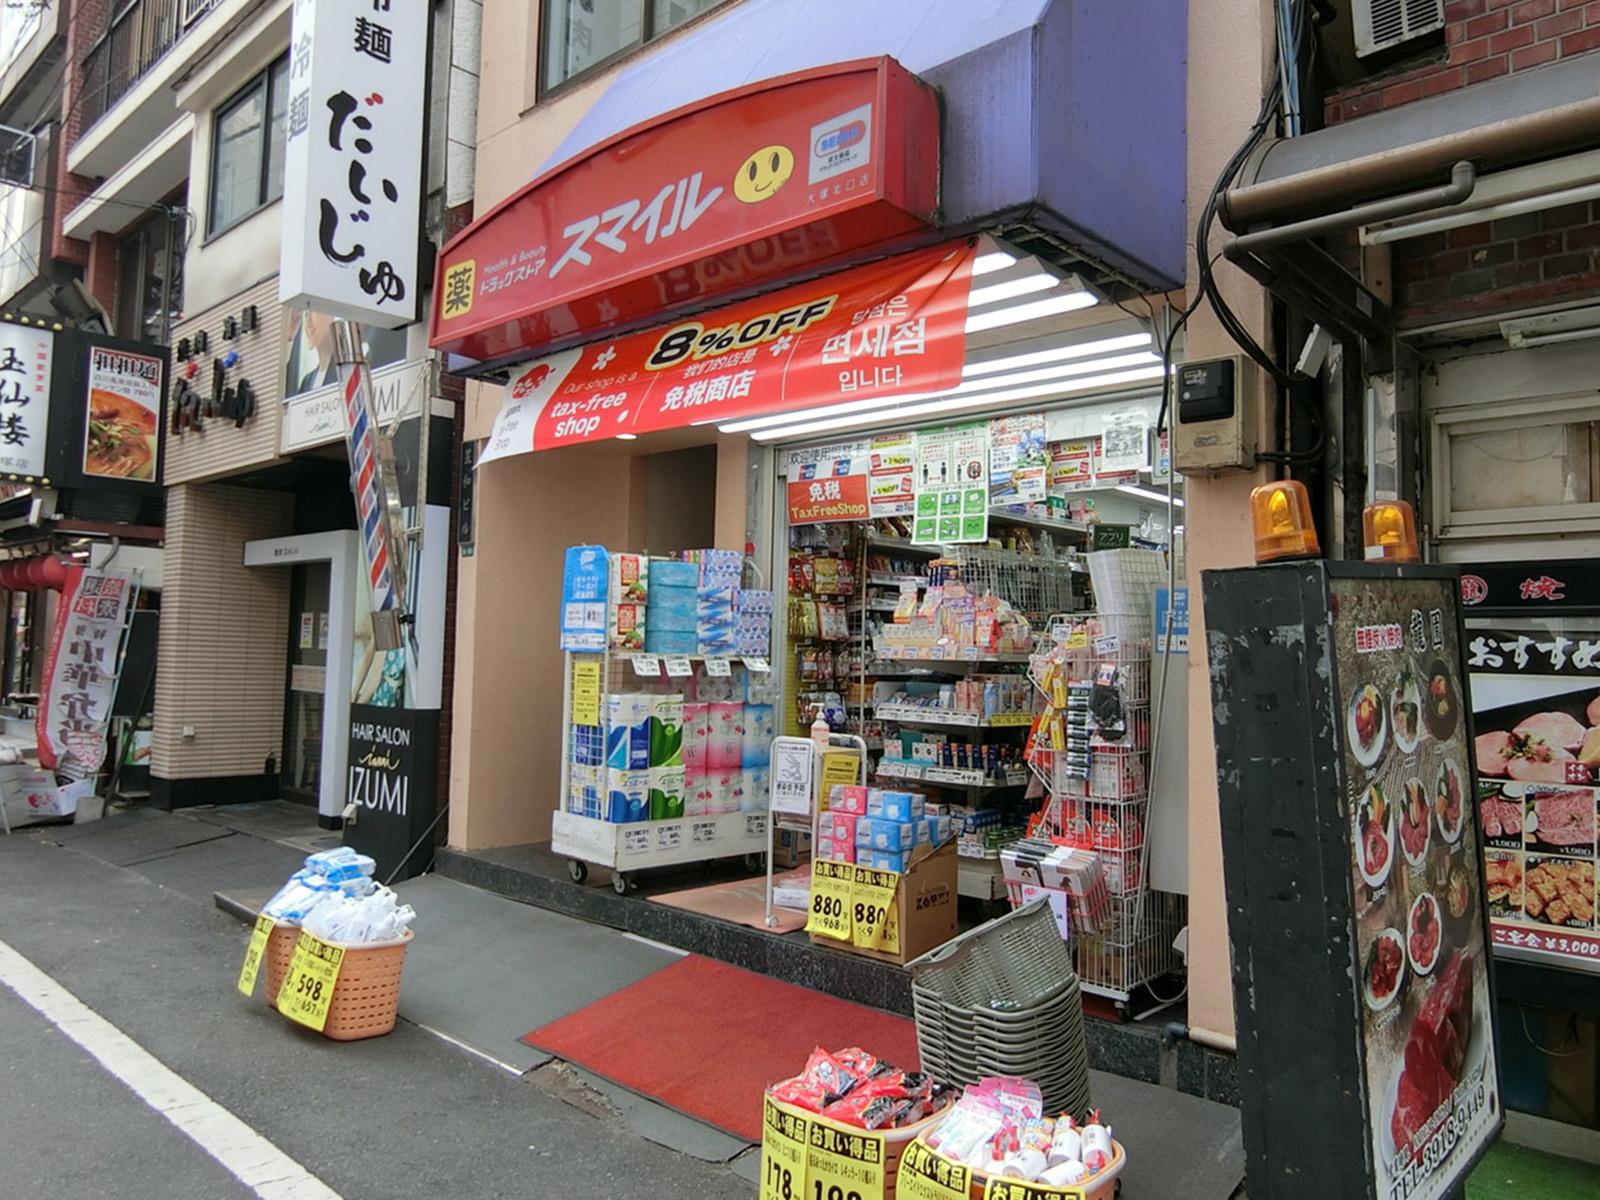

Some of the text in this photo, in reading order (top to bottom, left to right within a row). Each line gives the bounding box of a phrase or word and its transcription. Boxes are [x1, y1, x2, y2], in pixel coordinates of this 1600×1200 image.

[549, 172, 724, 278] スマイル
[483, 245, 547, 275] Health & Beauty
[445, 266, 473, 314] 薬
[822, 317, 926, 365] 면세점
[563, 371, 638, 395] Our shop is a
[660, 368, 756, 412] 免税商店
[838, 365, 904, 393] 입니다
[305, 398, 341, 418] HAIR SALO
[551, 391, 628, 418] tax-free
[554, 415, 600, 438] shop
[808, 480, 841, 503] 免税
[791, 502, 867, 519] TaxFreeShop
[351, 721, 411, 747] HAIR SALON
[348, 765, 409, 816] IZUMI
[813, 893, 843, 918] 880
[296, 973, 323, 1001] 598
[811, 1122, 879, 1163] お買い得品
[905, 1142, 965, 1192] お買い得品
